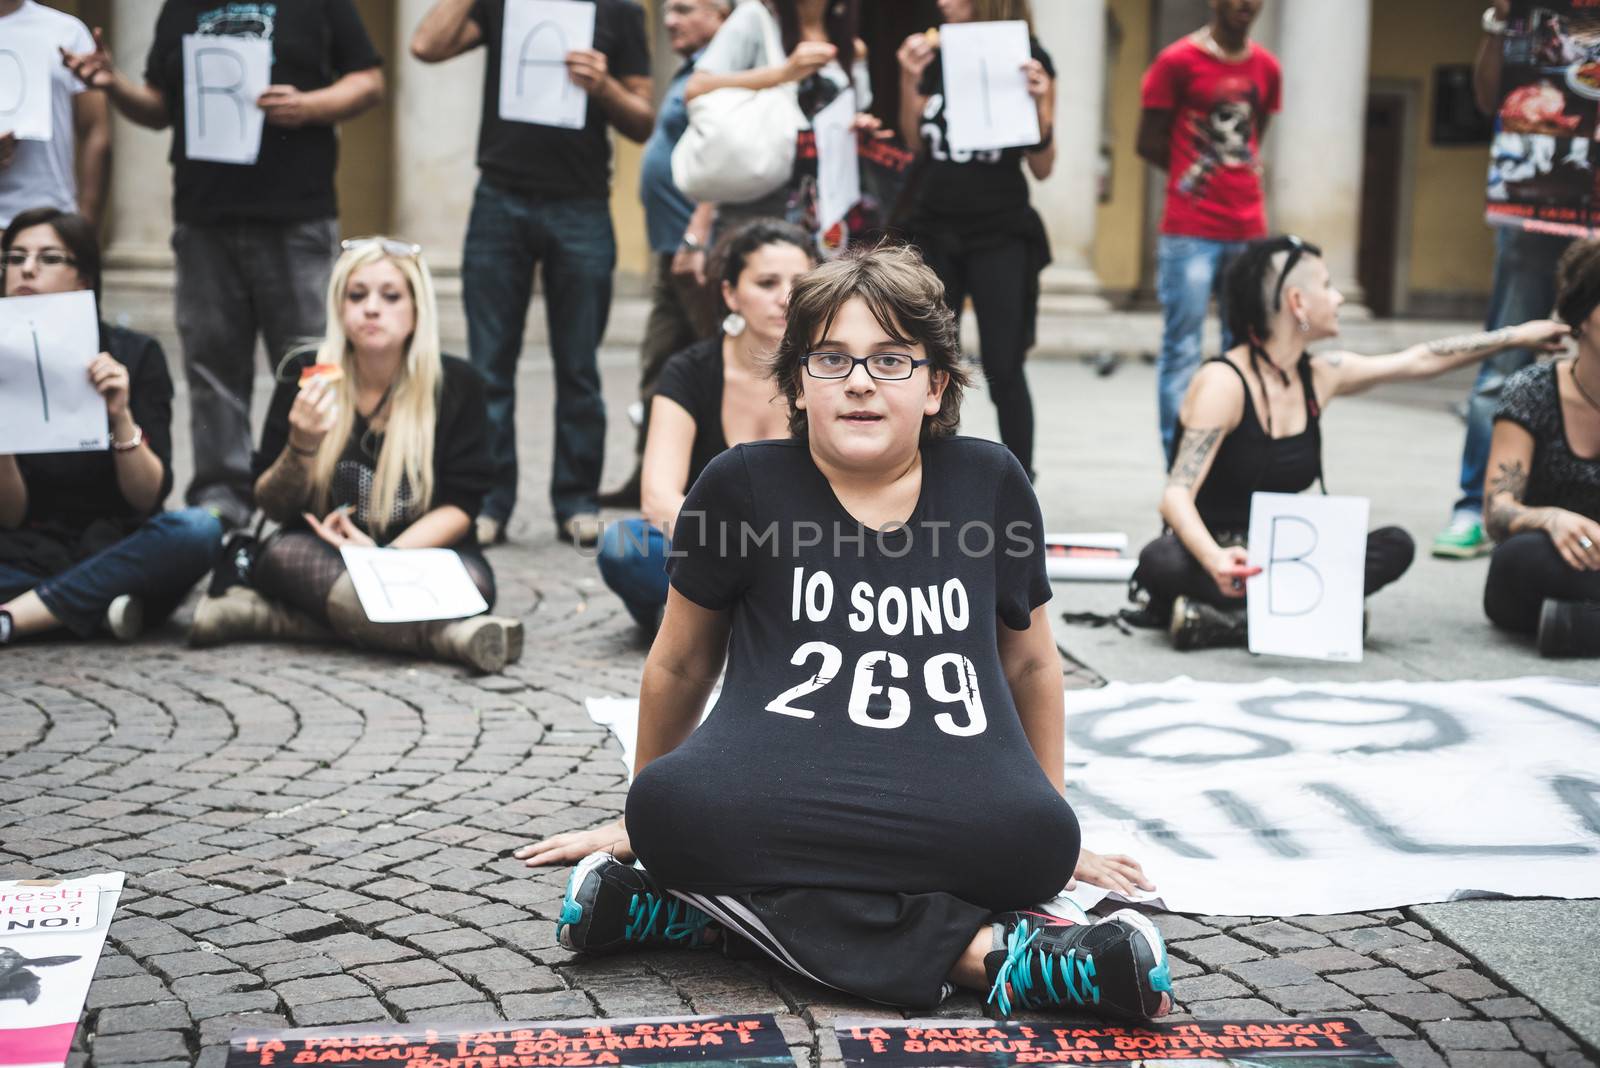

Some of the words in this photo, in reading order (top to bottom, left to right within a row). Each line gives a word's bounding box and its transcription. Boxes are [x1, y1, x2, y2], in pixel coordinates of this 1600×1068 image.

[515, 20, 570, 101] A
[194, 46, 248, 141] R
[368, 557, 440, 609] R
[1269, 515, 1325, 618] B
[792, 566, 834, 623] IO
[848, 576, 971, 637] SONO
[764, 640, 988, 738] 269
[1065, 690, 1468, 768] 69
[0, 901, 83, 915] tto?
[7, 916, 81, 931] NO!
[246, 1036, 286, 1053] LA
[305, 1033, 409, 1050] PAURA
[582, 1025, 616, 1038] IL
[635, 1020, 764, 1035] SANGUE
[457, 1042, 497, 1057] LA
[513, 1032, 723, 1055] SOFFERENZA
[851, 1026, 891, 1040] LA
[905, 1027, 1009, 1041] PAURA
[1172, 1024, 1209, 1037] IL
[1223, 1021, 1351, 1036] SANGUE
[1056, 1037, 1099, 1050] LA
[1114, 1035, 1319, 1050] SOFFERENZA
[1015, 1049, 1225, 1063] SOFFERENZA
